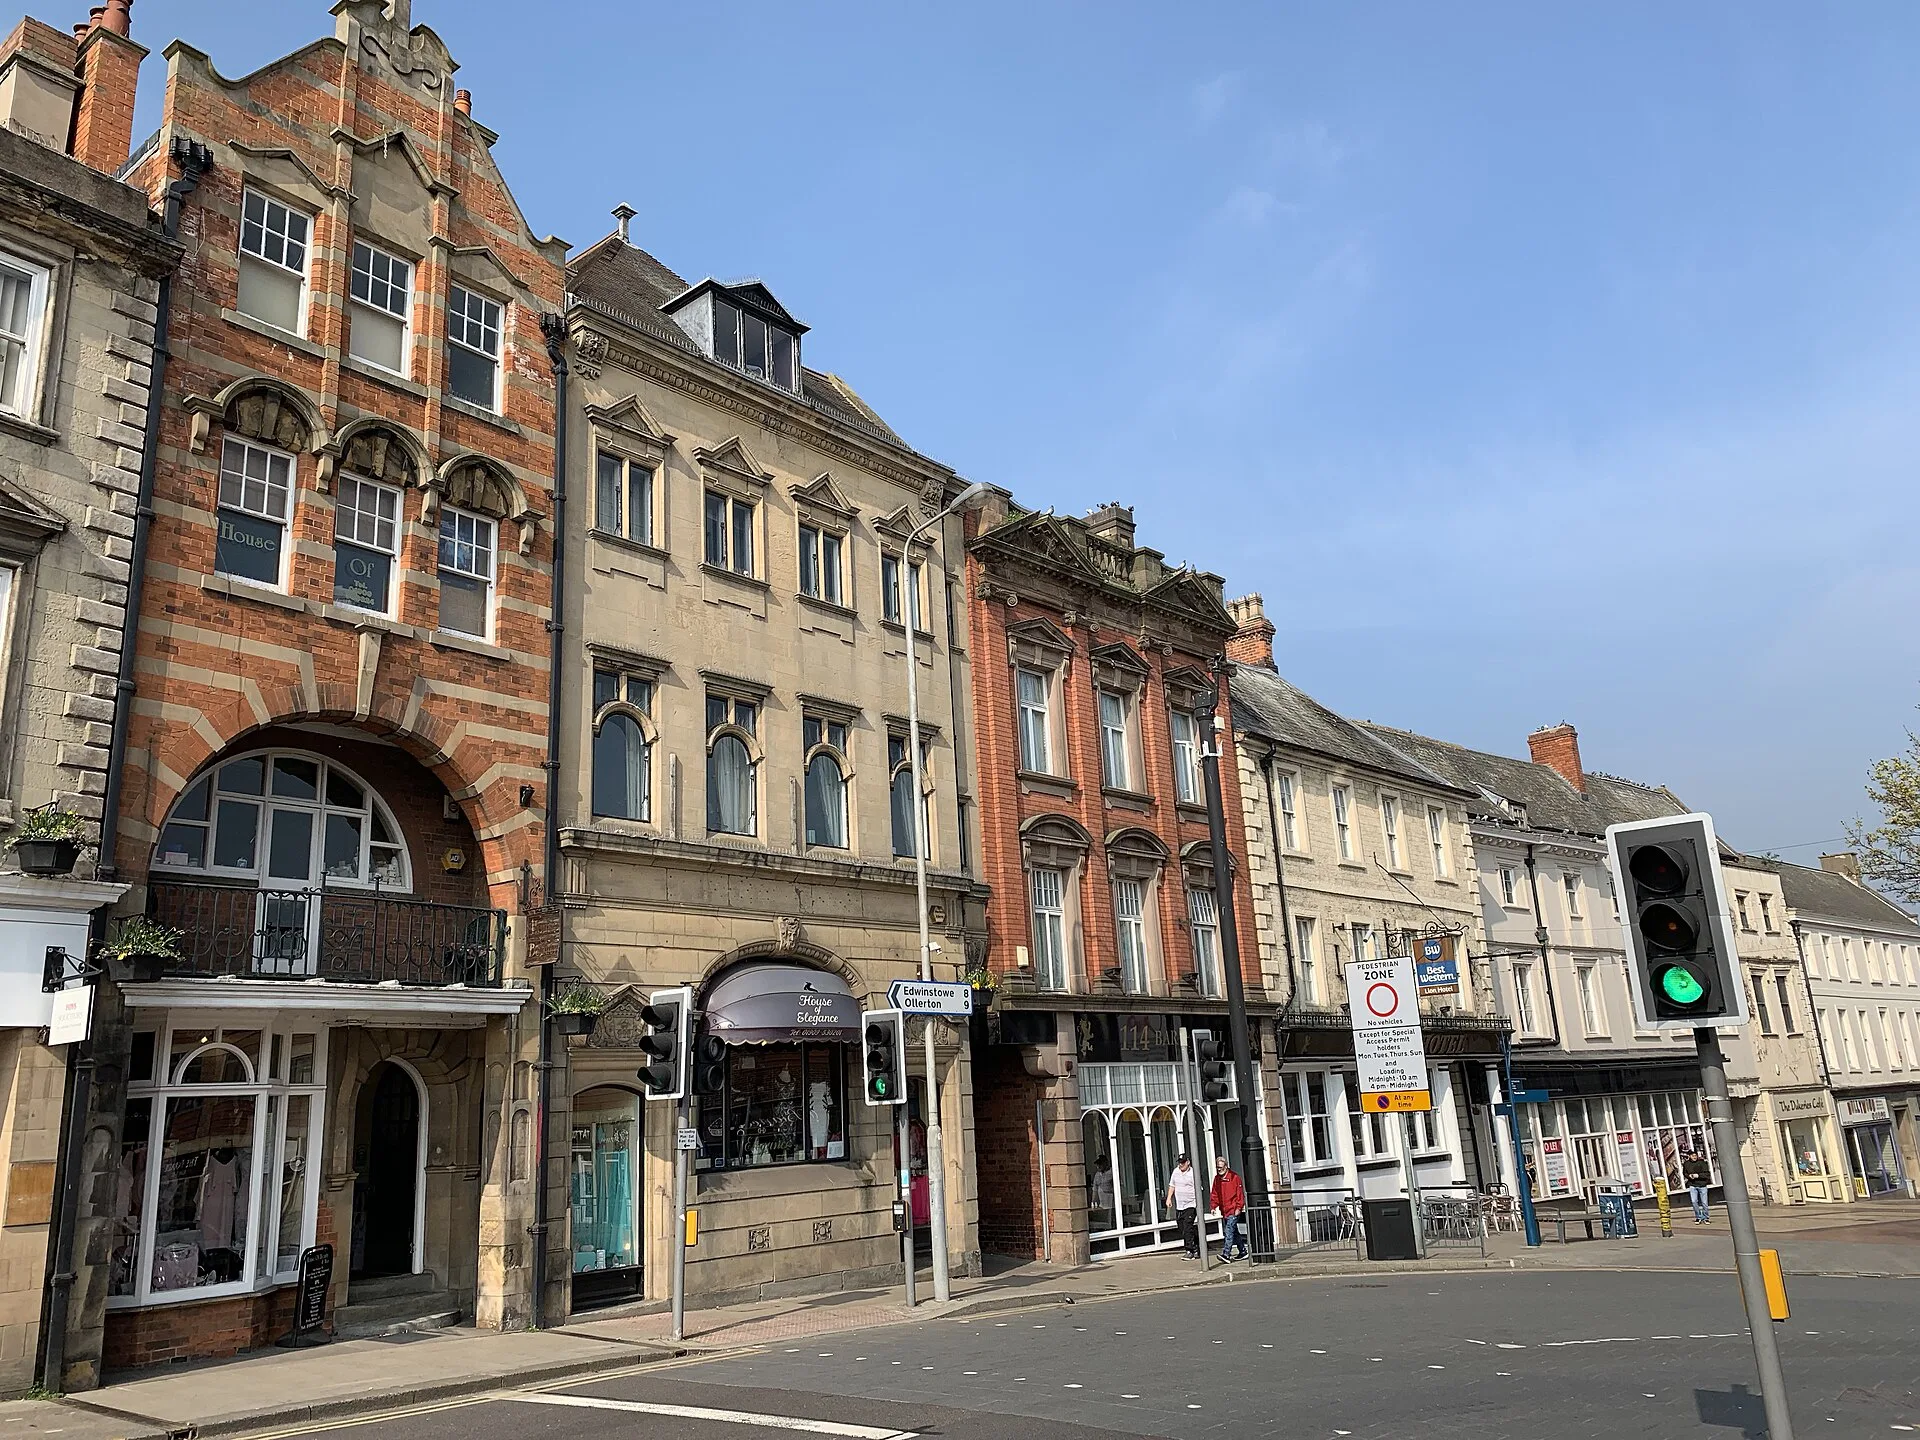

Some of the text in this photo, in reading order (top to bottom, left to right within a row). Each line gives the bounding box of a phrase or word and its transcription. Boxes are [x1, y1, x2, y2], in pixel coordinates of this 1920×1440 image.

[220, 521, 275, 550] House
[350, 558, 375, 578] Of
[1424, 945, 1441, 956] BW
[1357, 961, 1399, 970] PEDESTRIAN
[1426, 966, 1446, 975] Best
[1364, 969, 1395, 981] ZONE
[903, 986, 970, 998] Edwinstowe 8
[798, 995, 833, 1007] House
[904, 998, 970, 1010] Ollerton 9
[814, 1005, 822, 1016] of
[796, 1011, 839, 1026] Elegance
[1377, 1018, 1404, 1026] vehicles
[1120, 1024, 1179, 1051] 114 BAR
[1391, 1028, 1416, 1036] Special
[1779, 1101, 1790, 1112] The
